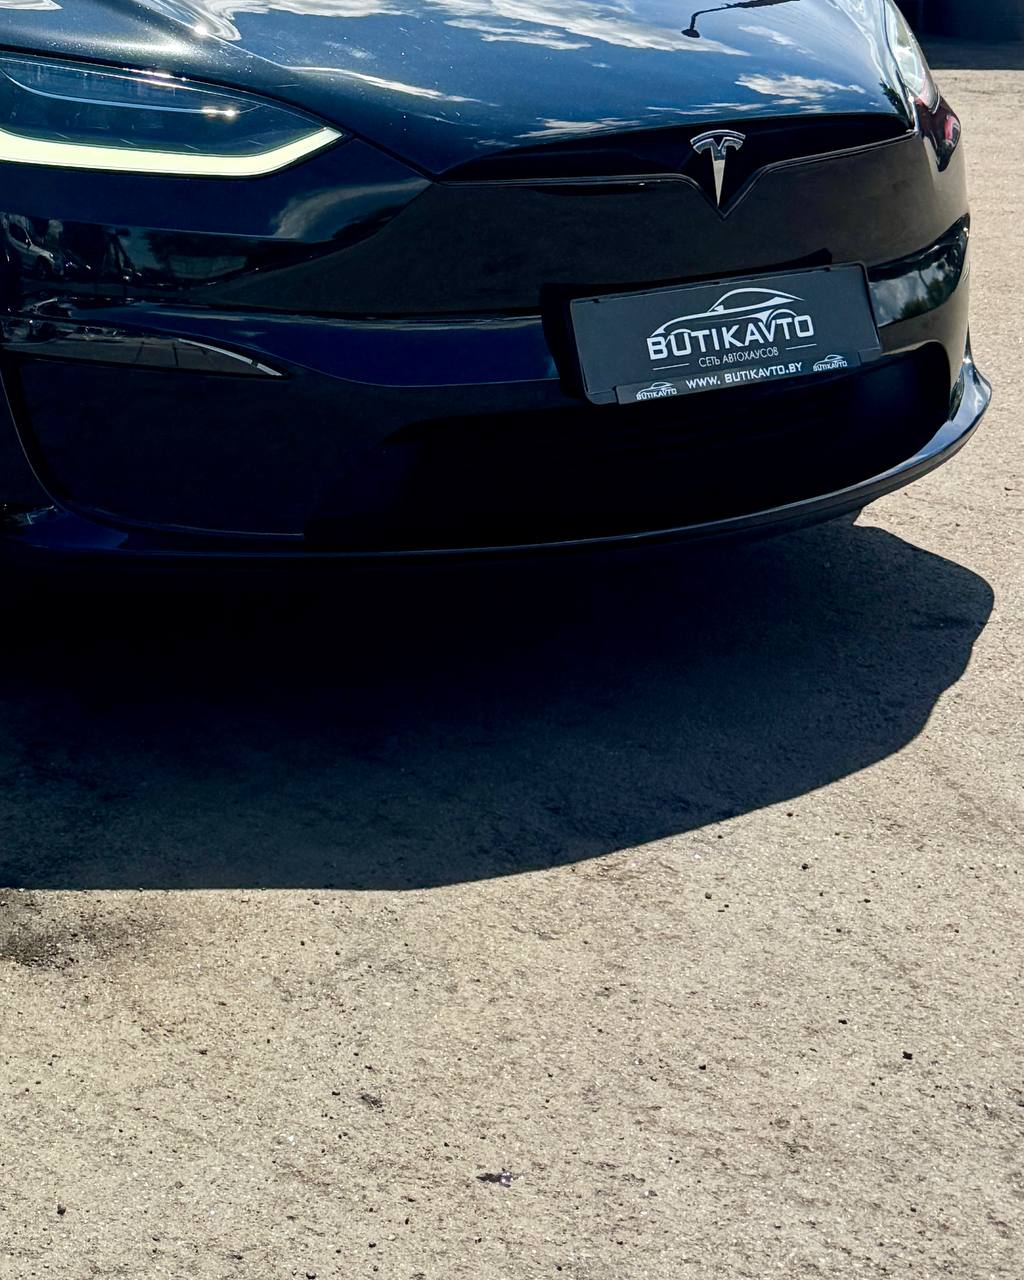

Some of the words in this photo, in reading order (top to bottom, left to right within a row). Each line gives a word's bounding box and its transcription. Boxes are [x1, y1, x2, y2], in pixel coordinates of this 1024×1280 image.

[647, 315, 814, 360] BUTIKAVTO
[699, 355, 720, 368] СЕТЬ
[723, 346, 779, 364] АВТОХАУСОВ
[685, 375, 721, 390] WWW.
[724, 362, 803, 383] BUTIKAVTO.BY
[636, 387, 677, 401] BUTIKAVTO
